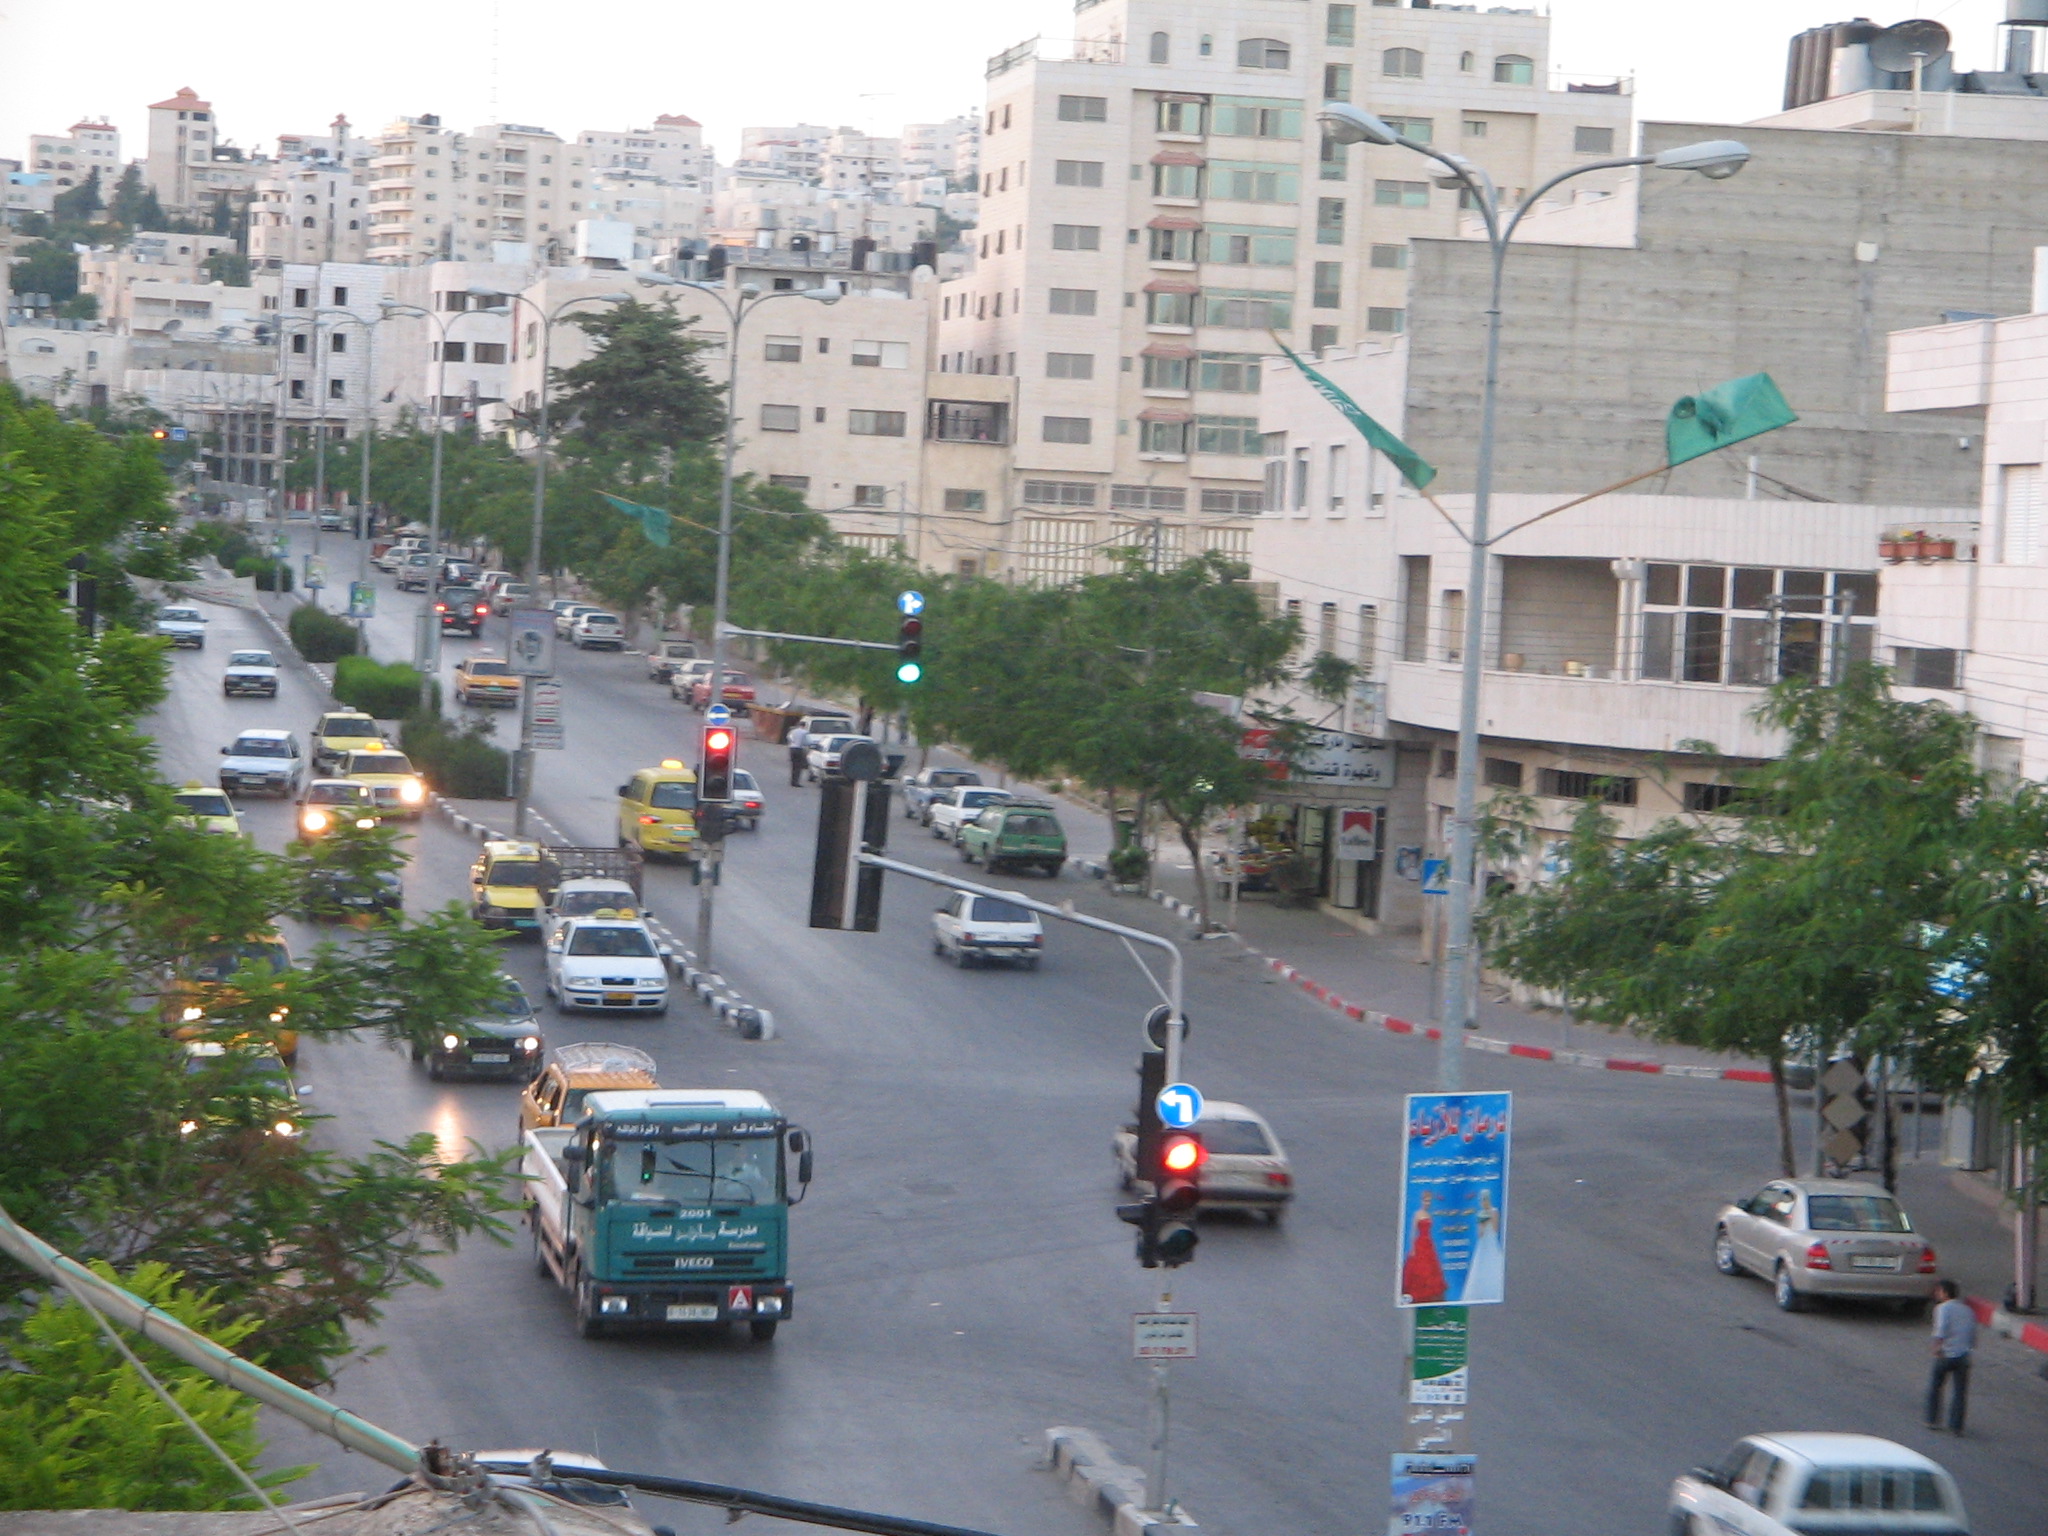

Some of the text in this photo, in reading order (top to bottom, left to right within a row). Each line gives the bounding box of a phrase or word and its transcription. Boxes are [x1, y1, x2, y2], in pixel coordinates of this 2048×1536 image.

[680, 1208, 713, 1219] 2001
[718, 1220, 758, 1240] مدرسة
[674, 1257, 715, 1269] IVECO
